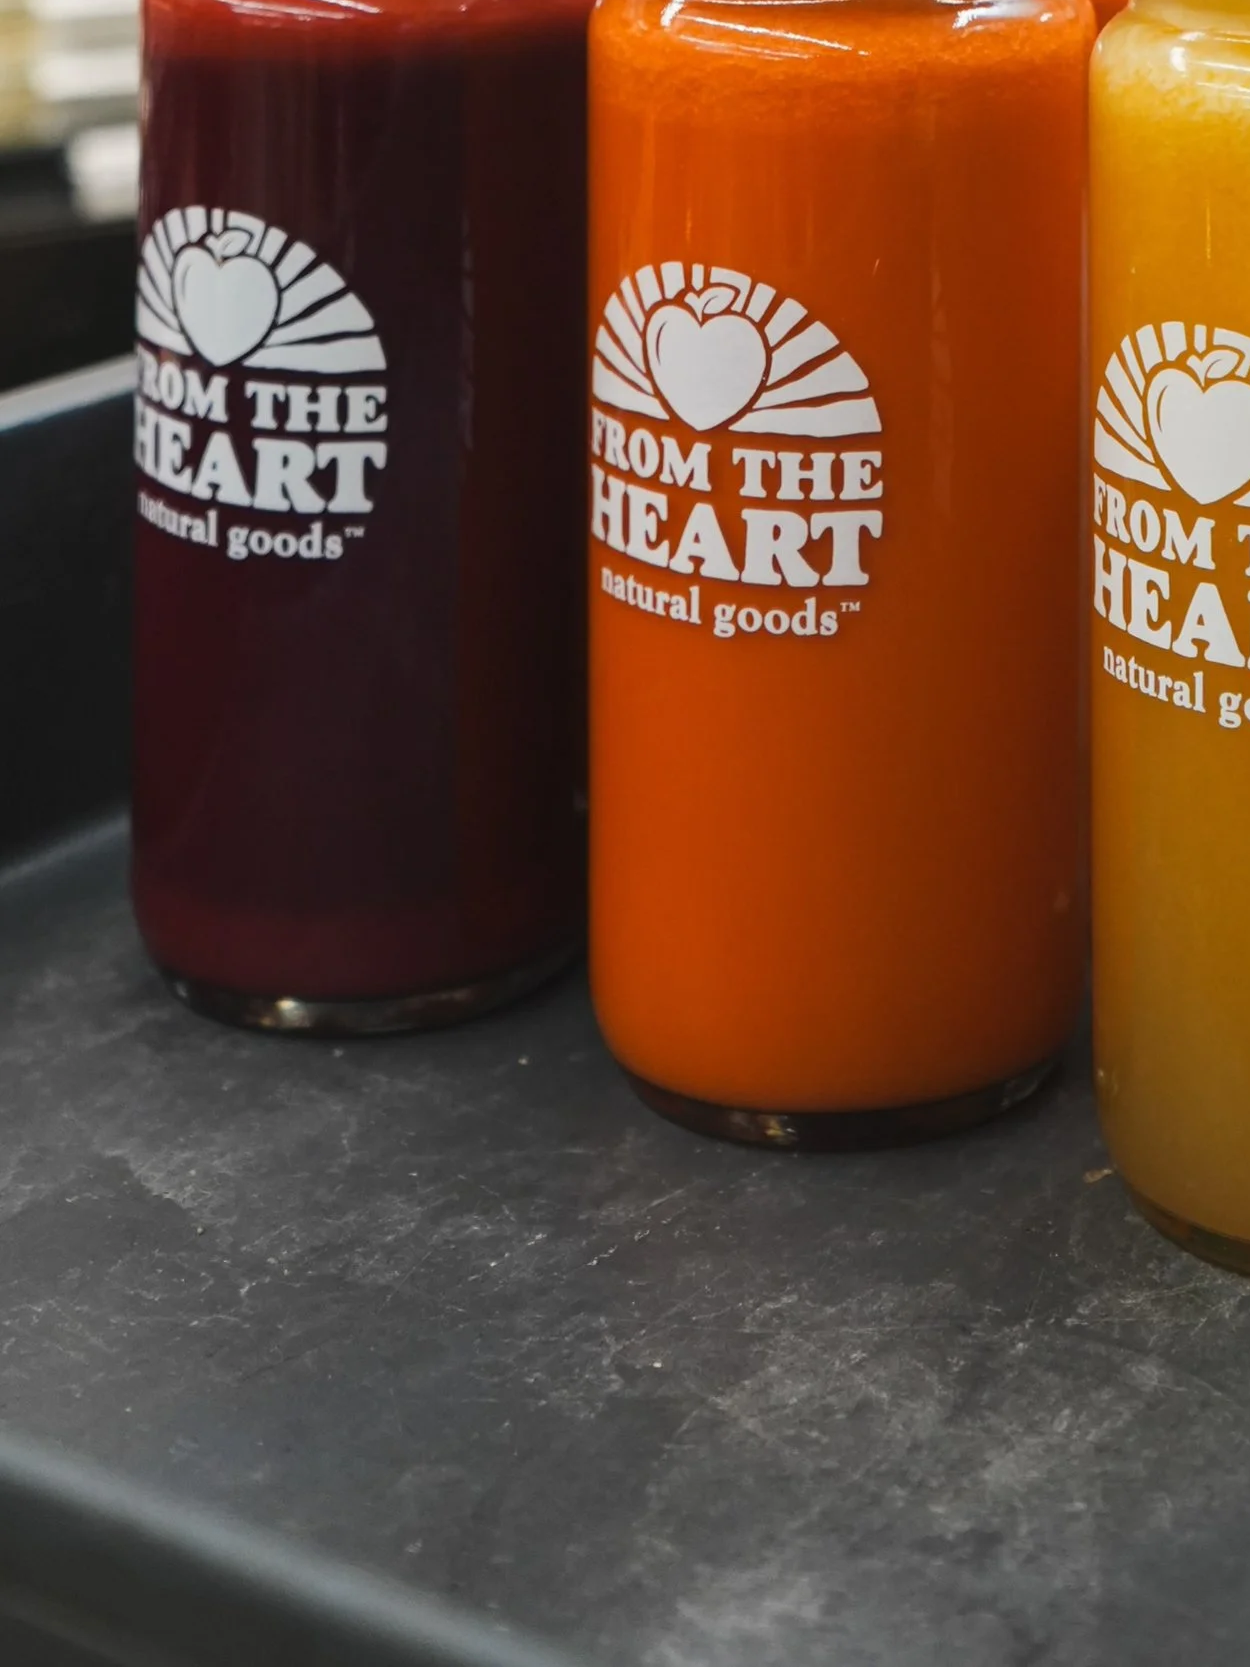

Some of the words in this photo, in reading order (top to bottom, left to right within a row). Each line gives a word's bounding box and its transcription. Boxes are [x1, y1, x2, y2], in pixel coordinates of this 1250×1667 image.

[135, 341, 229, 424] ROM
[244, 380, 388, 434] THE
[133, 397, 388, 514] HEART
[591, 406, 712, 492] FROM
[731, 447, 883, 500] THE
[137, 490, 218, 548] natural
[591, 463, 883, 588] HEART
[1093, 472, 1216, 571] FROM
[601, 565, 701, 625] natural
[1102, 645, 1206, 714] natural
